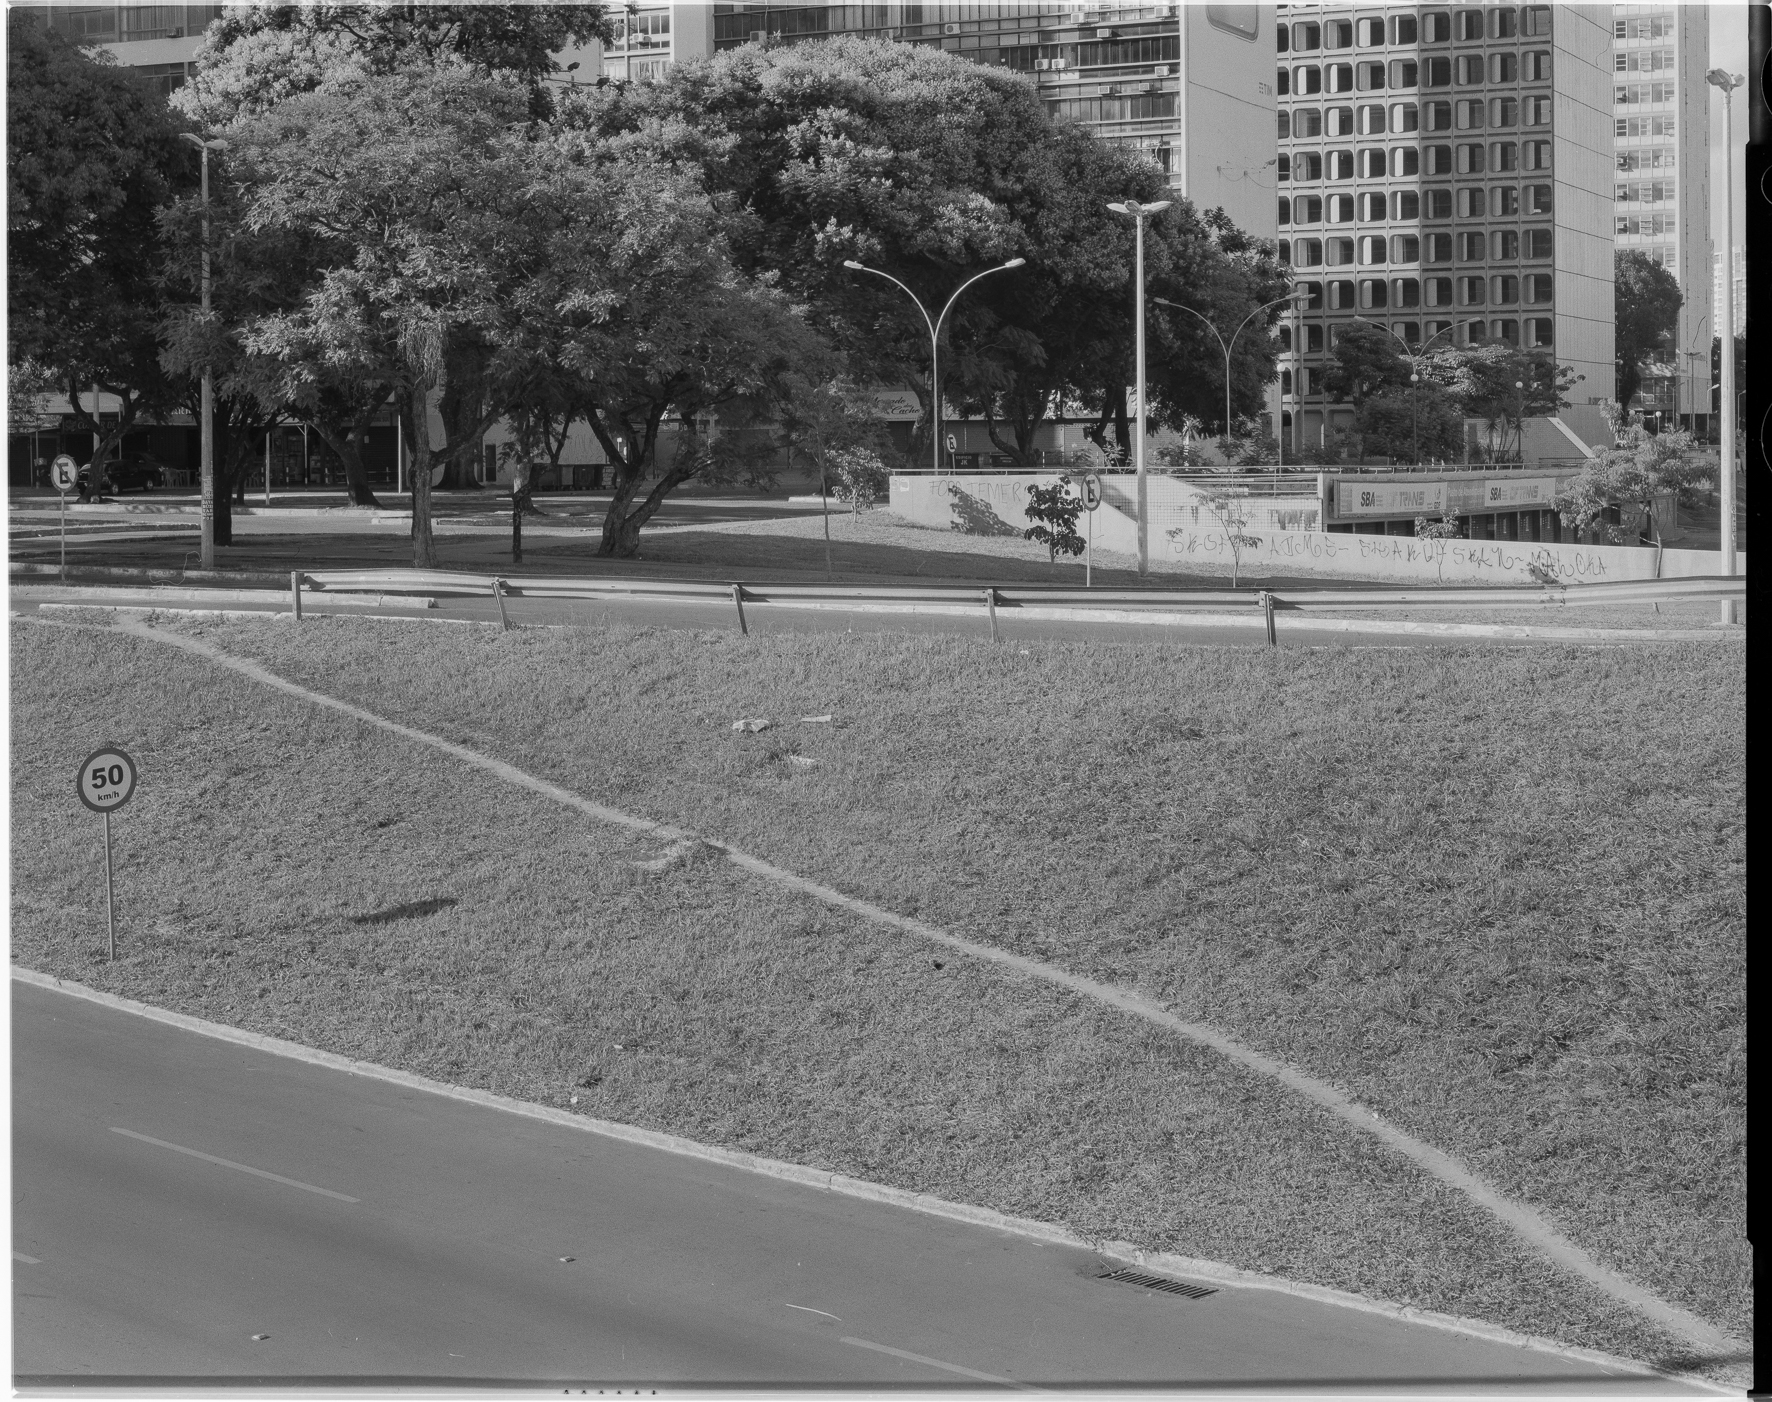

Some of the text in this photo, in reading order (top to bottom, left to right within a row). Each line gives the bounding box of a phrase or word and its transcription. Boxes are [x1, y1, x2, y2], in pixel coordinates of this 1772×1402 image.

[966, 482, 1021, 504] TEMER
[1360, 491, 1376, 507] SBA
[1490, 487, 1502, 501] SBA
[92, 764, 124, 789] 50
[97, 791, 120, 801] km/h
